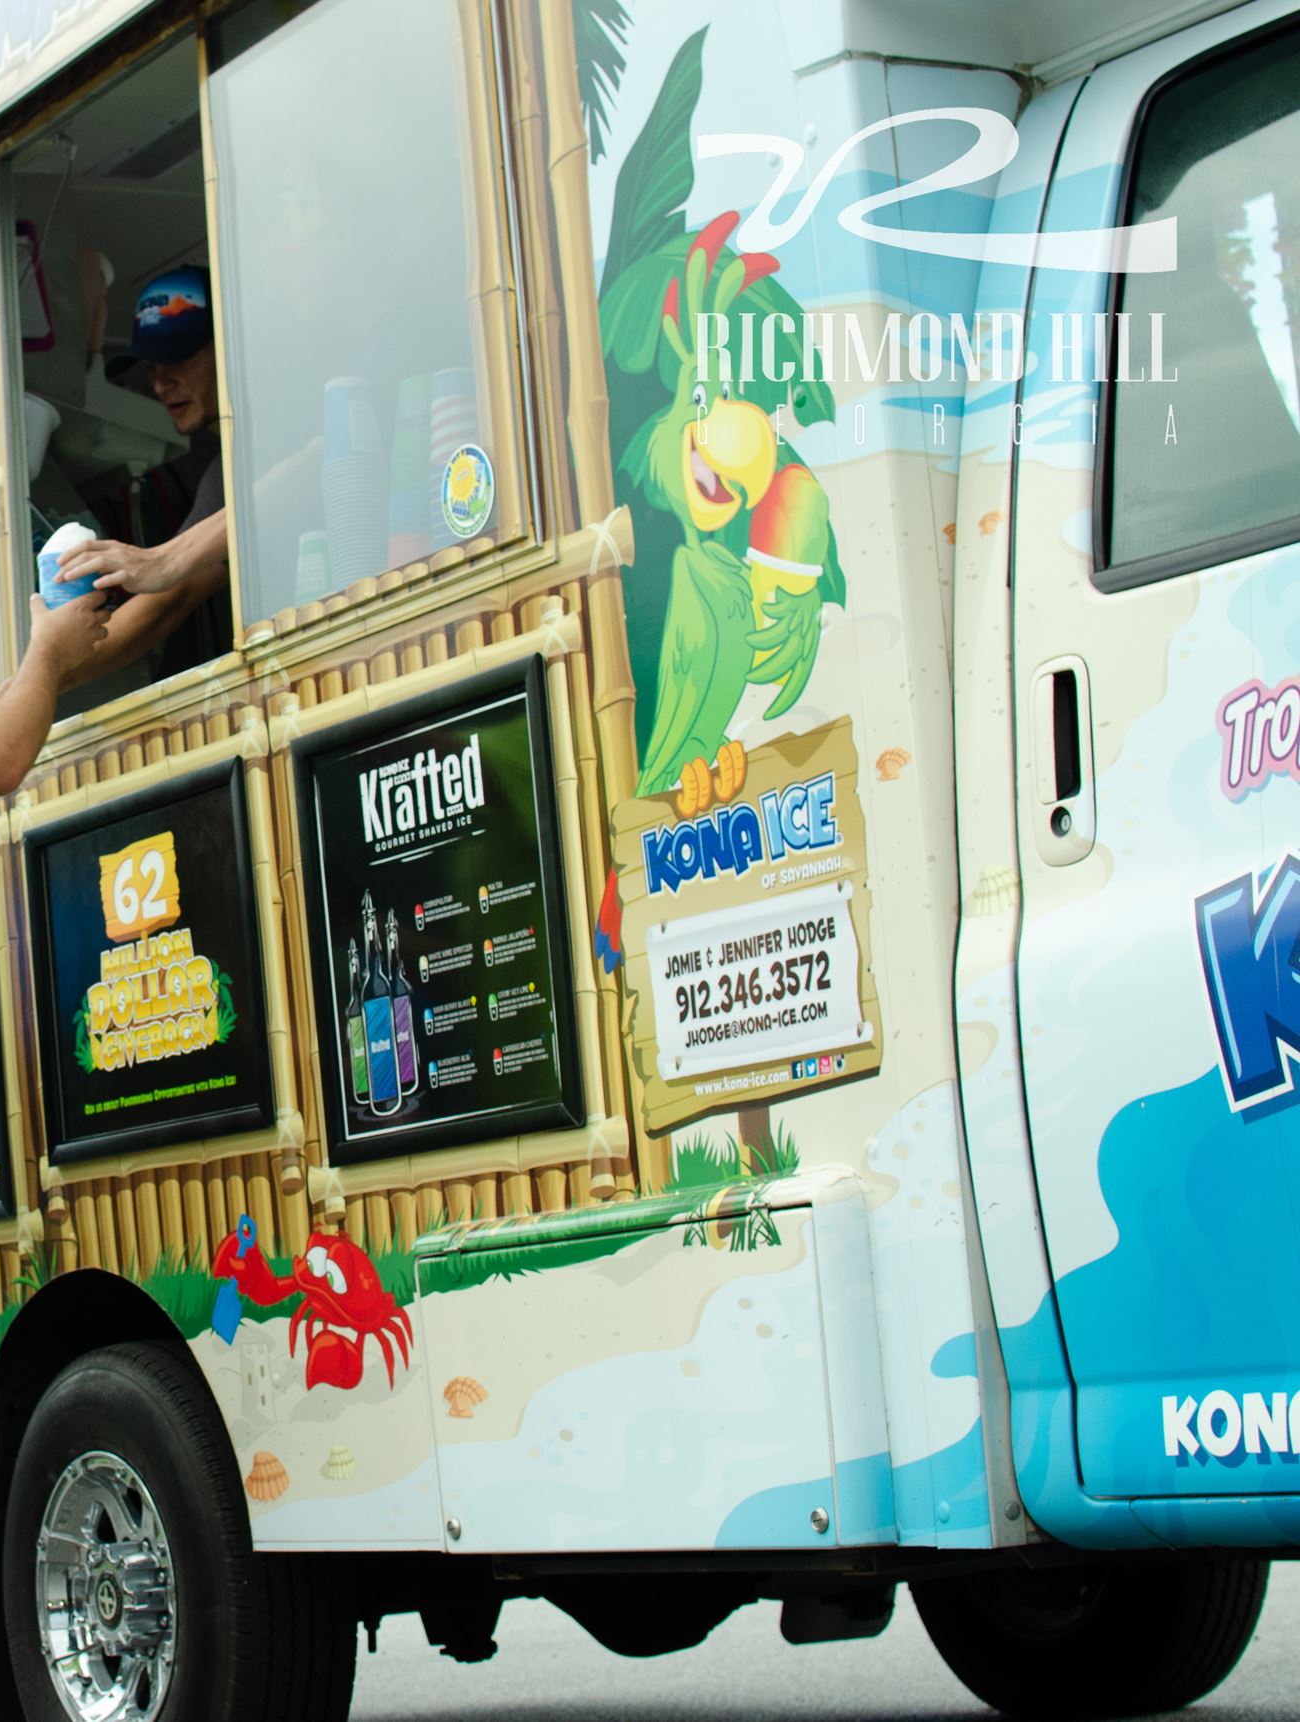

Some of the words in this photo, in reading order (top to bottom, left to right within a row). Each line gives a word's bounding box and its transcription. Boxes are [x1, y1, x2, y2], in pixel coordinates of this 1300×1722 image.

[1220, 683, 1300, 789] Tro
[360, 733, 485, 843] Krafted
[374, 832, 416, 853] GOURMET
[418, 821, 453, 840] SHAVED
[456, 814, 473, 828] ICE
[642, 804, 764, 895] KONA
[760, 773, 837, 863] ICE
[113, 850, 168, 925] 62
[761, 873, 777, 889] OF
[780, 857, 843, 885] SAVANNAH
[100, 928, 195, 982] MILLION
[665, 950, 702, 979] JAMIE
[719, 929, 783, 966] JENNIFER
[787, 917, 836, 949] HODGE
[87, 955, 217, 1034] DOLLAR
[676, 951, 831, 1023] 912.346.3572
[102, 1013, 208, 1071] GIVEBACK
[685, 1001, 828, 1048] JHODGE@KONA-ICE.COM
[694, 1071, 789, 1096] www.kona-ice.com
[1162, 1389, 1300, 1458] KON
